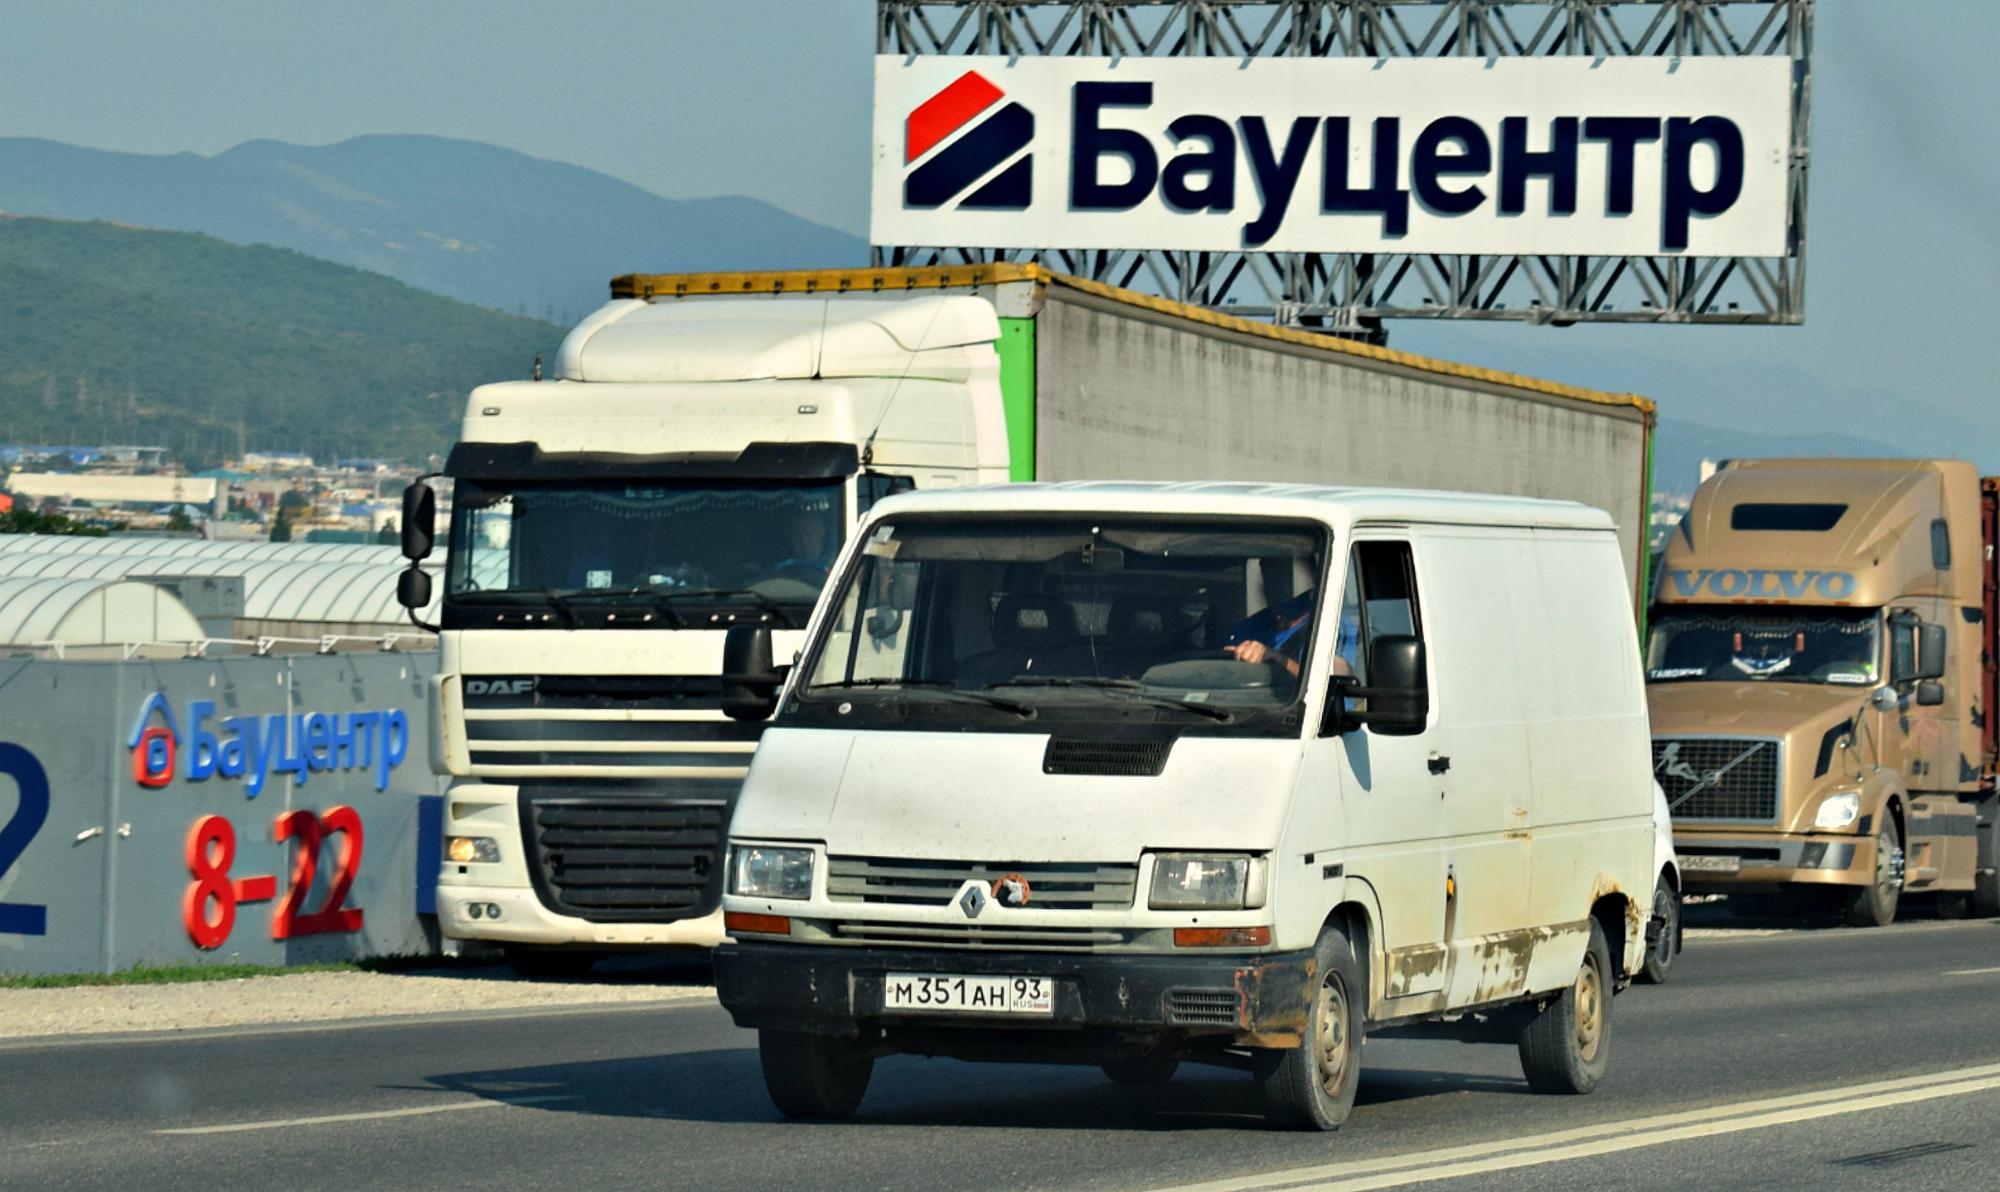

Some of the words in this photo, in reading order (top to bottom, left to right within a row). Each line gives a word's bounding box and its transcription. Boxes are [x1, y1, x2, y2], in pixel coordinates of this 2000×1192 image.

[1068, 80, 1744, 253] Бауцентр
[1671, 569, 1856, 599] VOLVO
[466, 680, 534, 695] DAF
[186, 701, 408, 798] Бауцентр
[185, 805, 364, 949] 8-22
[1014, 979, 1041, 999] 93
[1013, 1001, 1034, 1009] RUS
